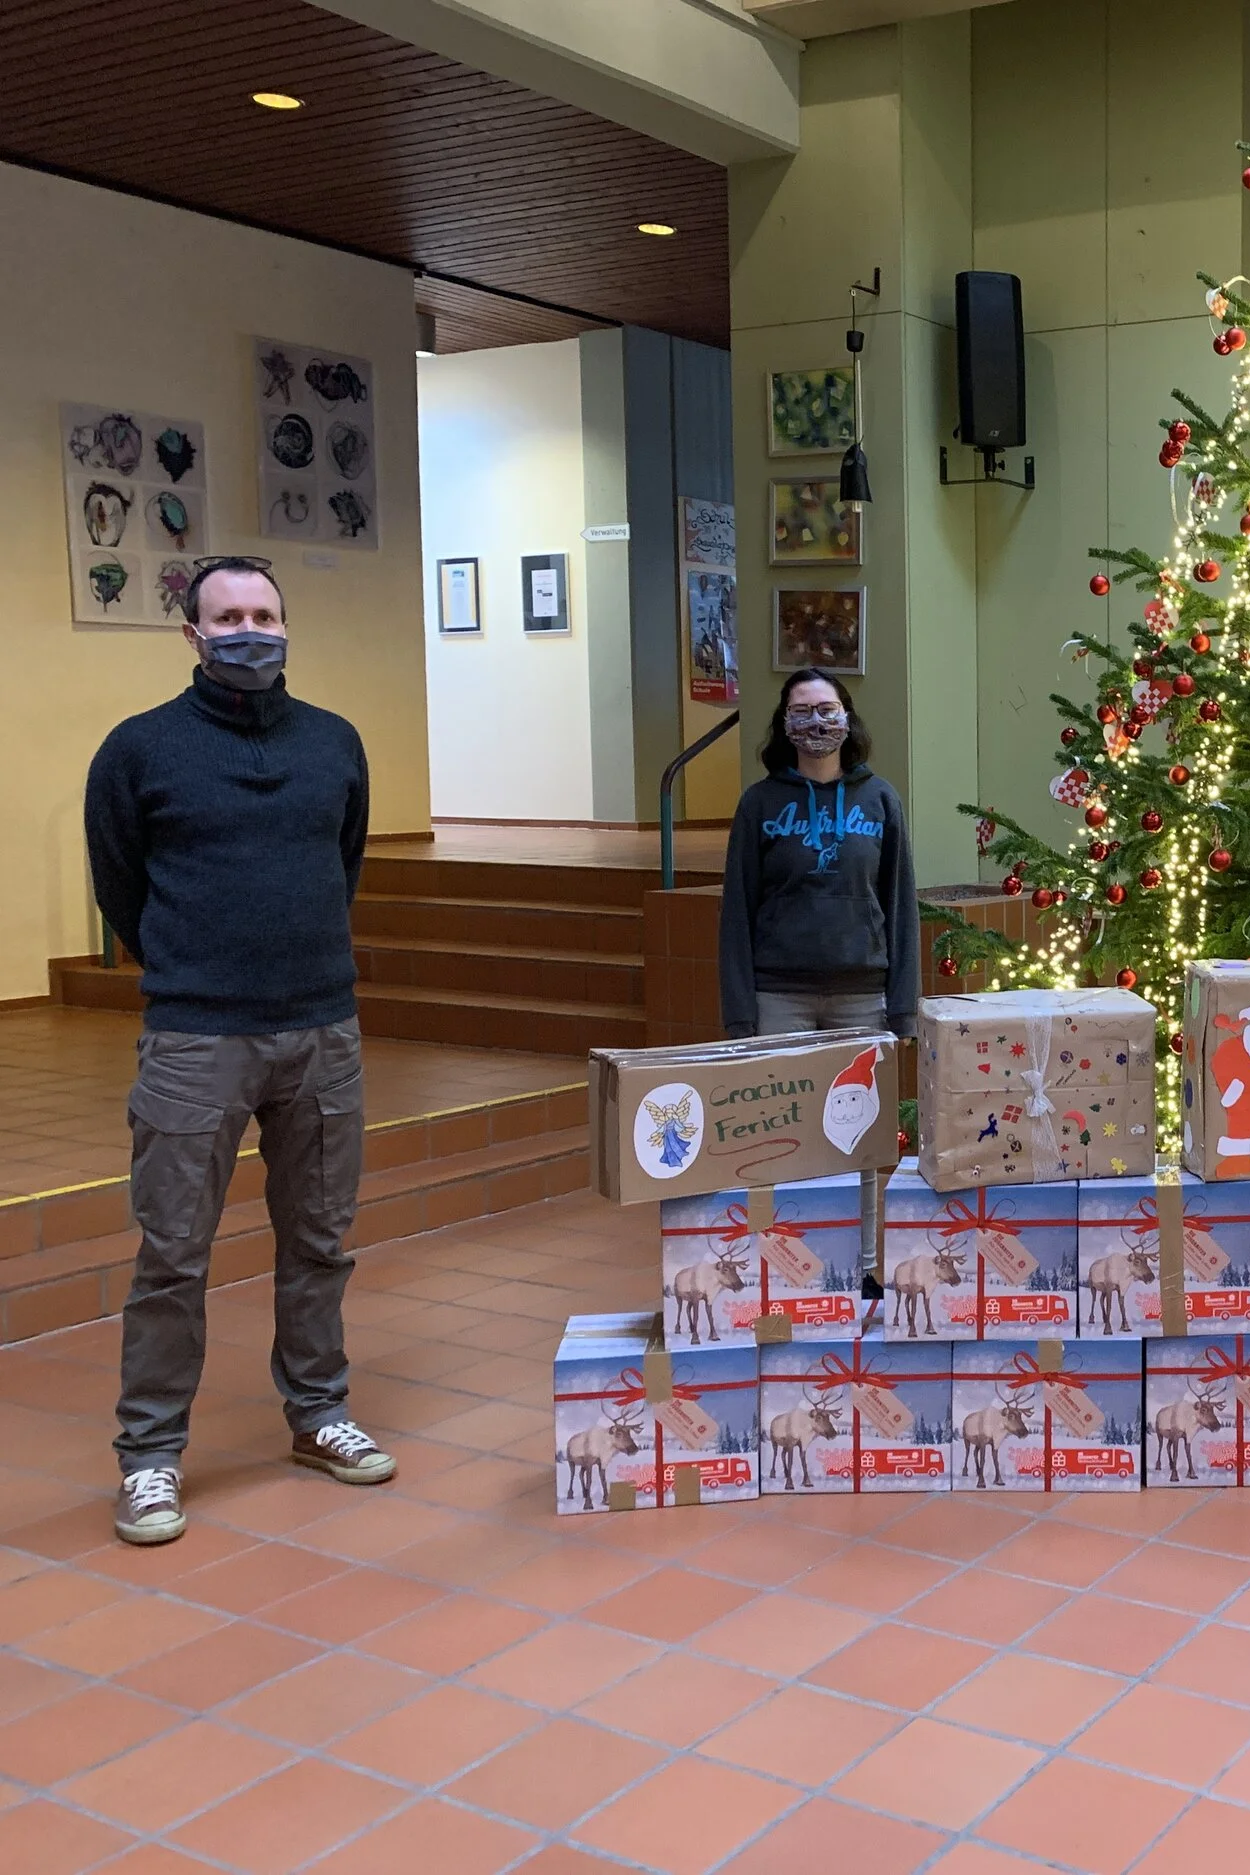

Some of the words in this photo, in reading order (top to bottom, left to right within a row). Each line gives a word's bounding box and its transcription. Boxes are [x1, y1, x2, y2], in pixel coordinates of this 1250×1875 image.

[590, 526, 627, 537] Verwaltung
[709, 1073, 815, 1107] Craciun
[714, 1101, 803, 1142] Fericit
